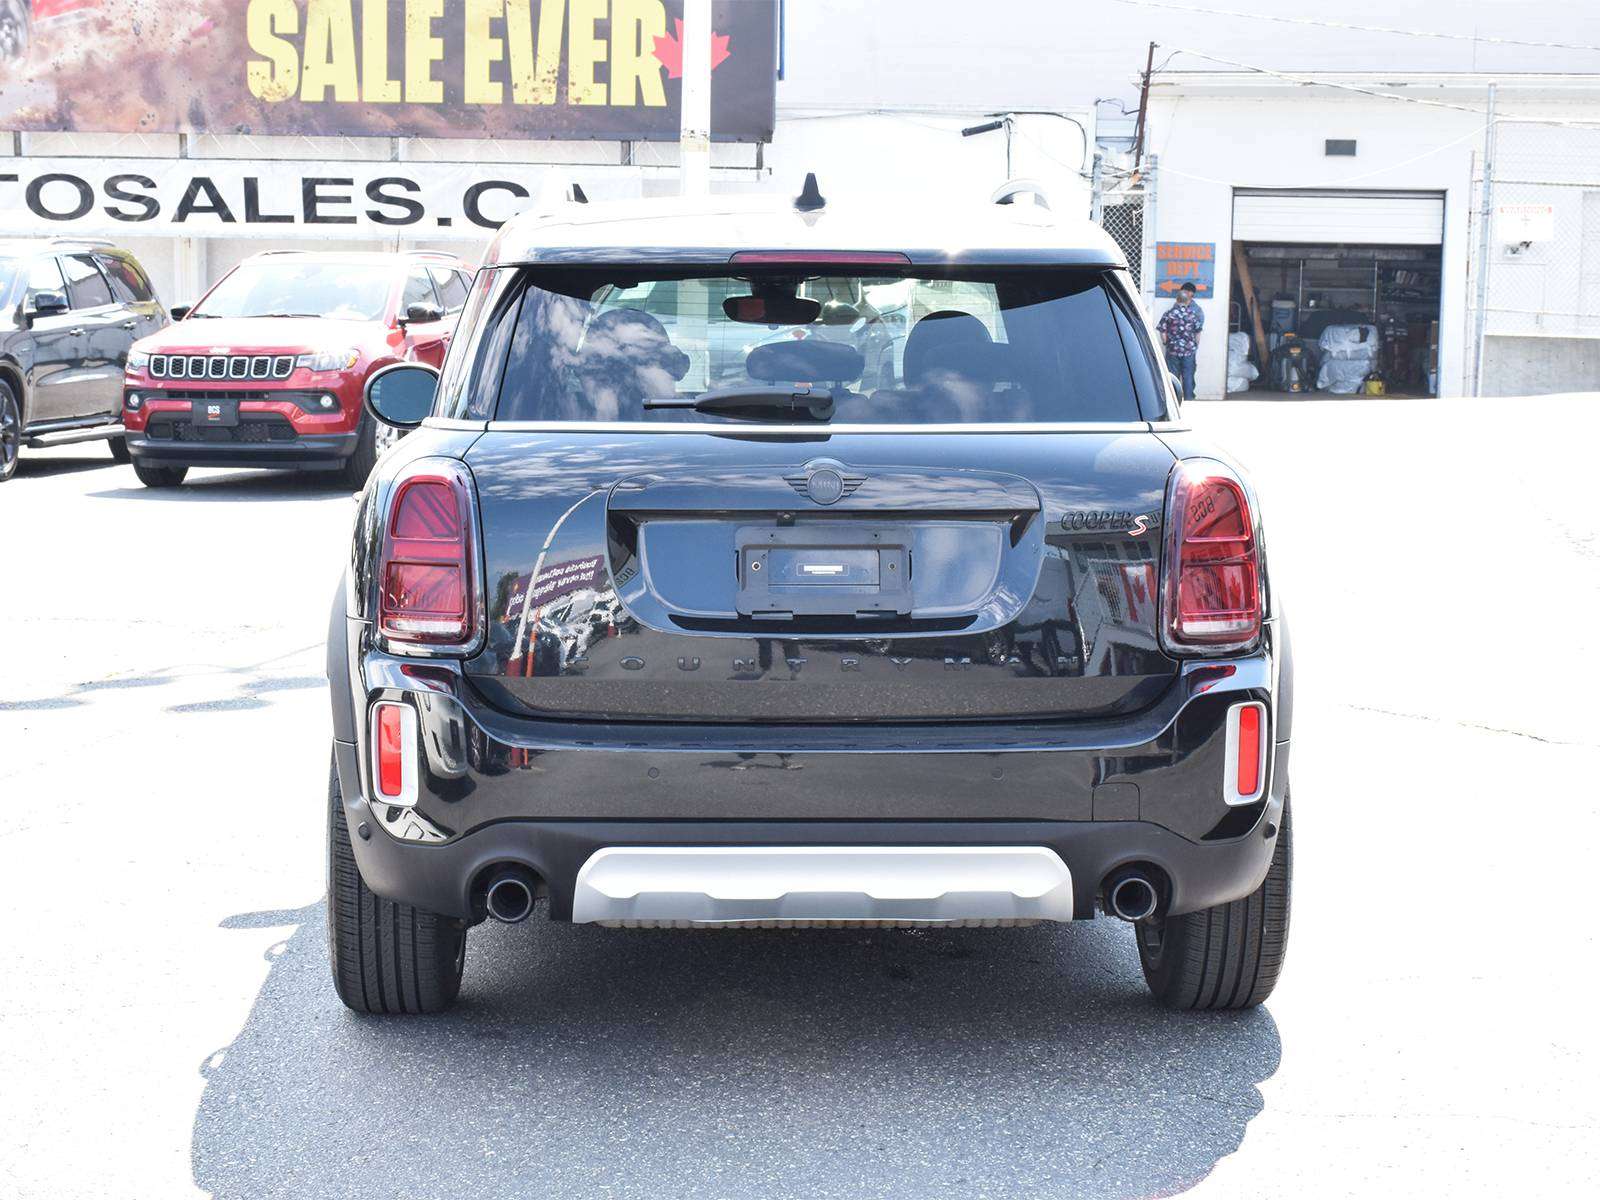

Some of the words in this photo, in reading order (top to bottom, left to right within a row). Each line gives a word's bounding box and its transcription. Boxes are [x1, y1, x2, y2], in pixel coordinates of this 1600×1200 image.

[247, 0, 443, 103] SALE
[464, 0, 667, 106] EVER
[0, 173, 589, 230] OSALES.C
[1061, 510, 1136, 530] COOPER
[1127, 514, 1149, 536] S
